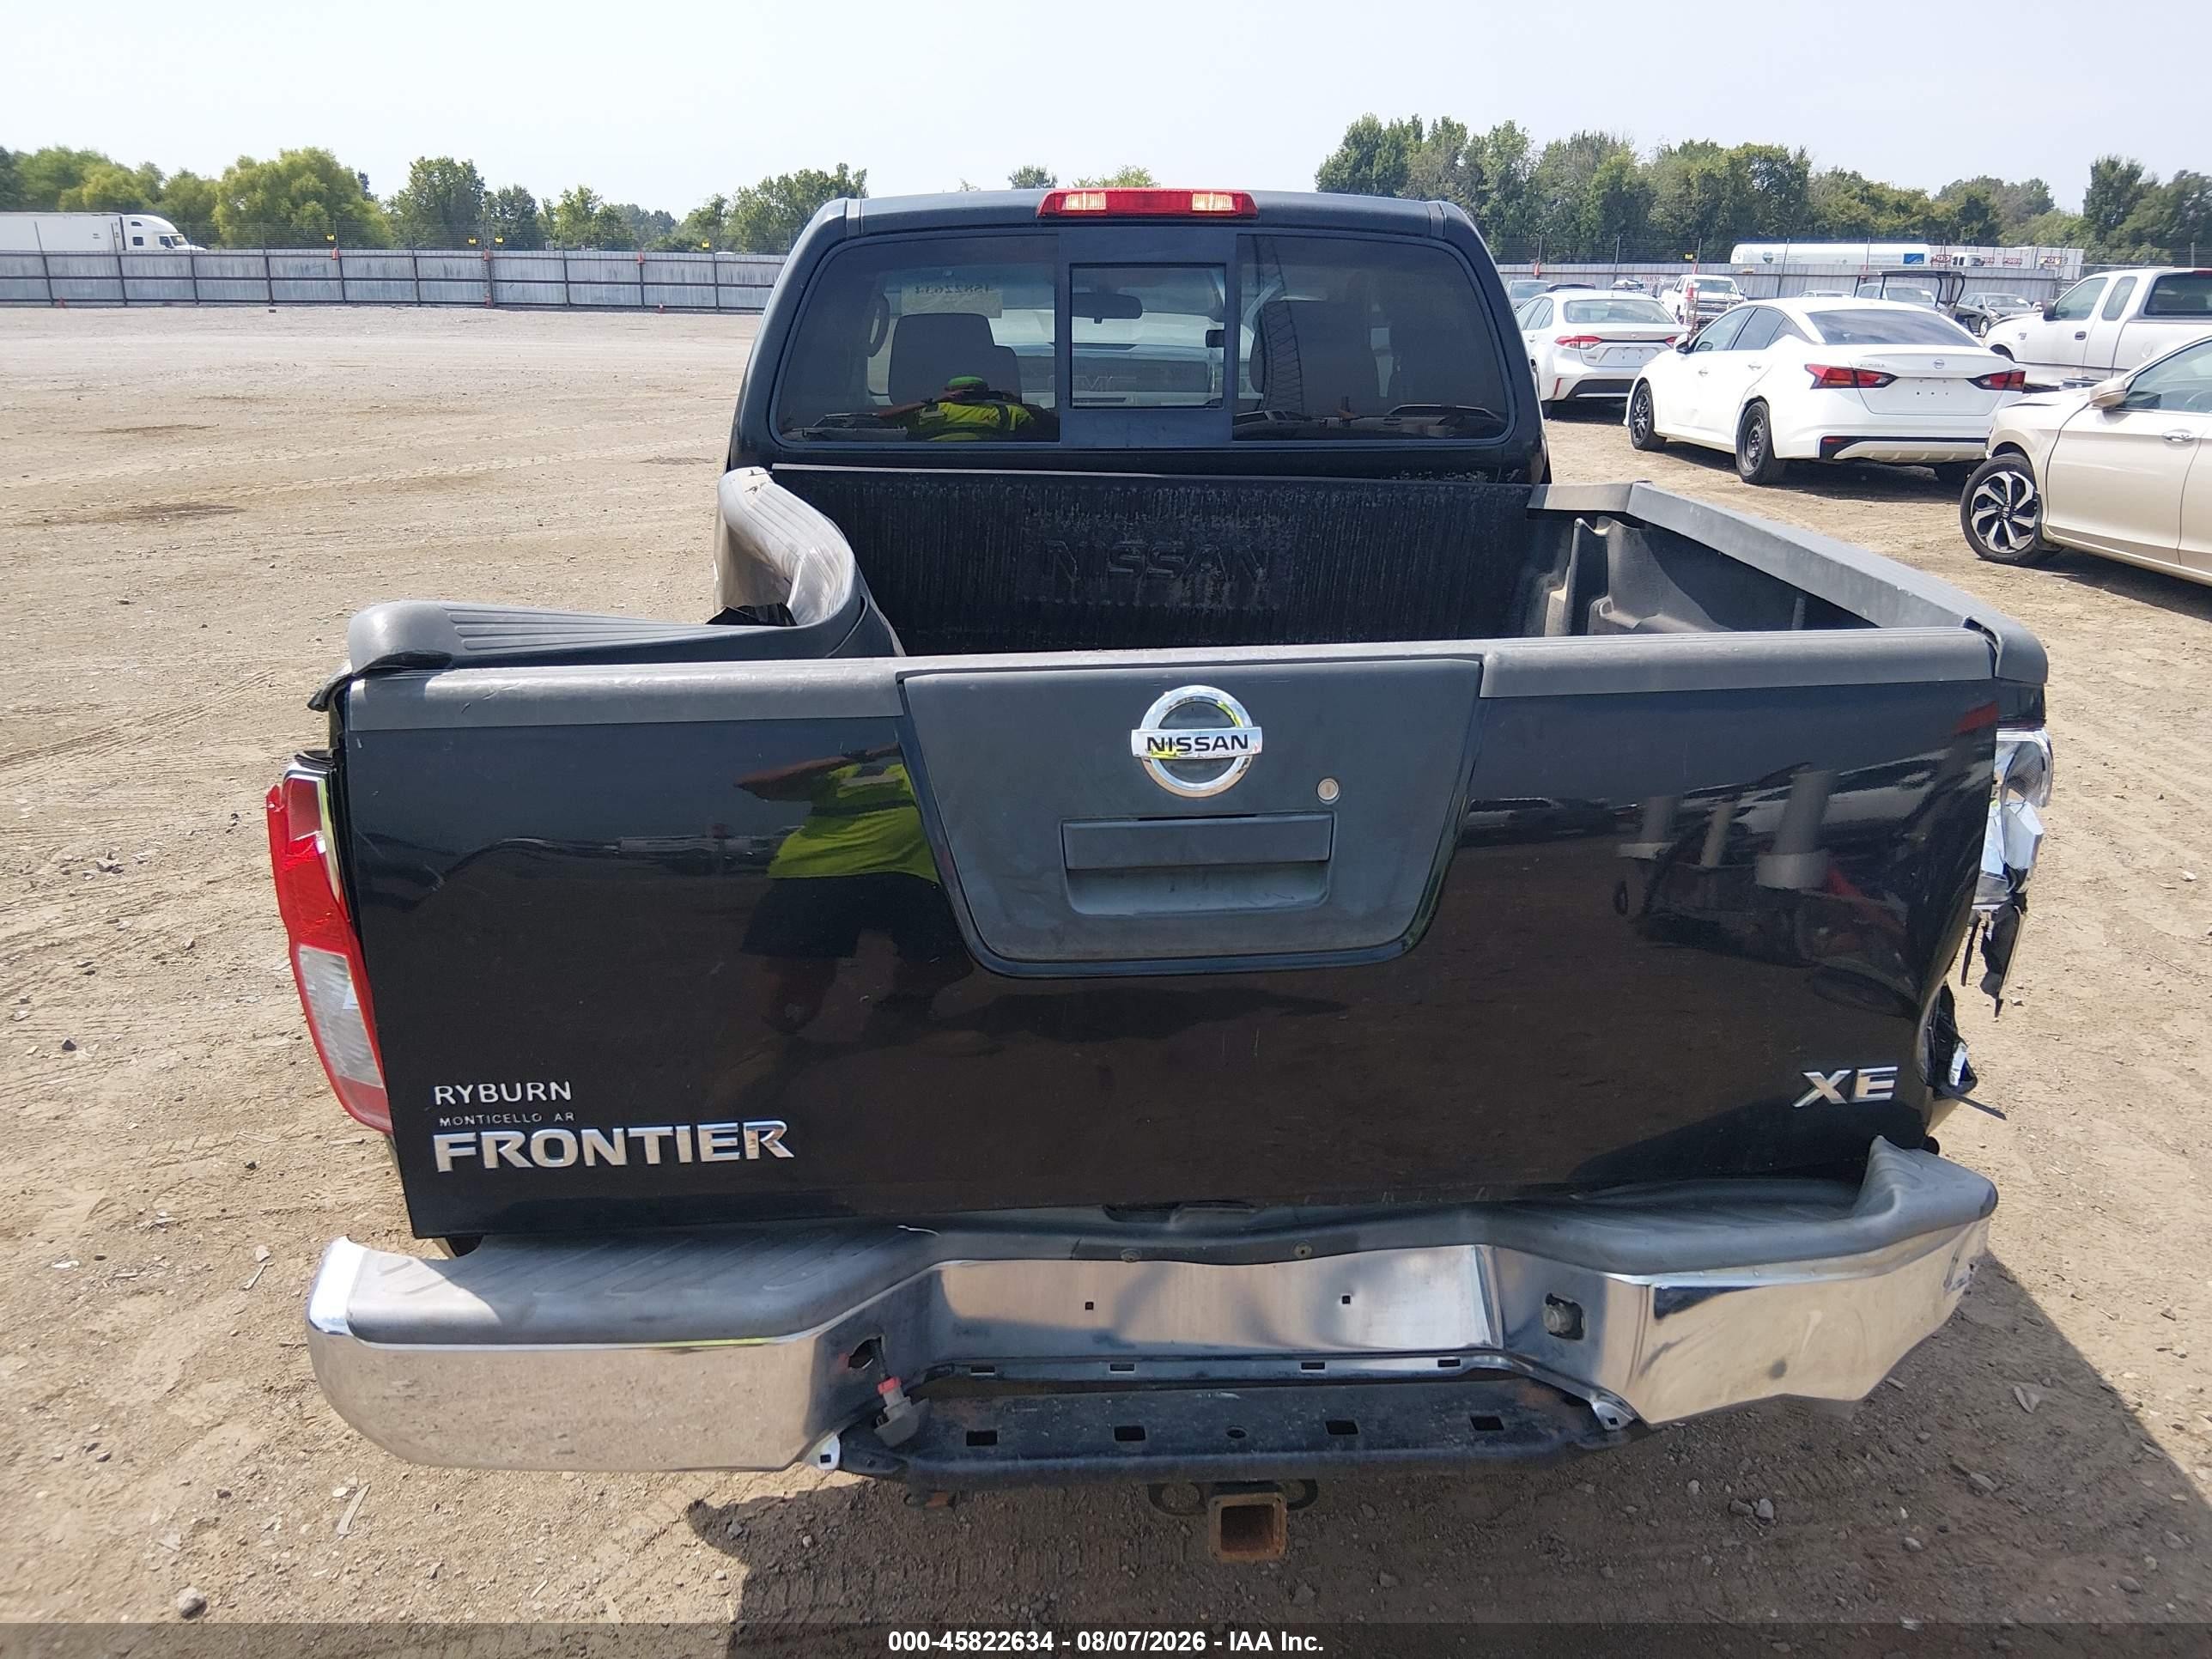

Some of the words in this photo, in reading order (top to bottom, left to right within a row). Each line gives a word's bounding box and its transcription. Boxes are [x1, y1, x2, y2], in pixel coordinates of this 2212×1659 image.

[1146, 734, 1249, 753] NISSAN
[433, 1080, 572, 1106] RYBURN
[1791, 1066, 1899, 1108] XE
[439, 1113, 543, 1127] MONTICELLO
[553, 1111, 575, 1122] AR
[433, 1120, 795, 1173] FRONTIER
